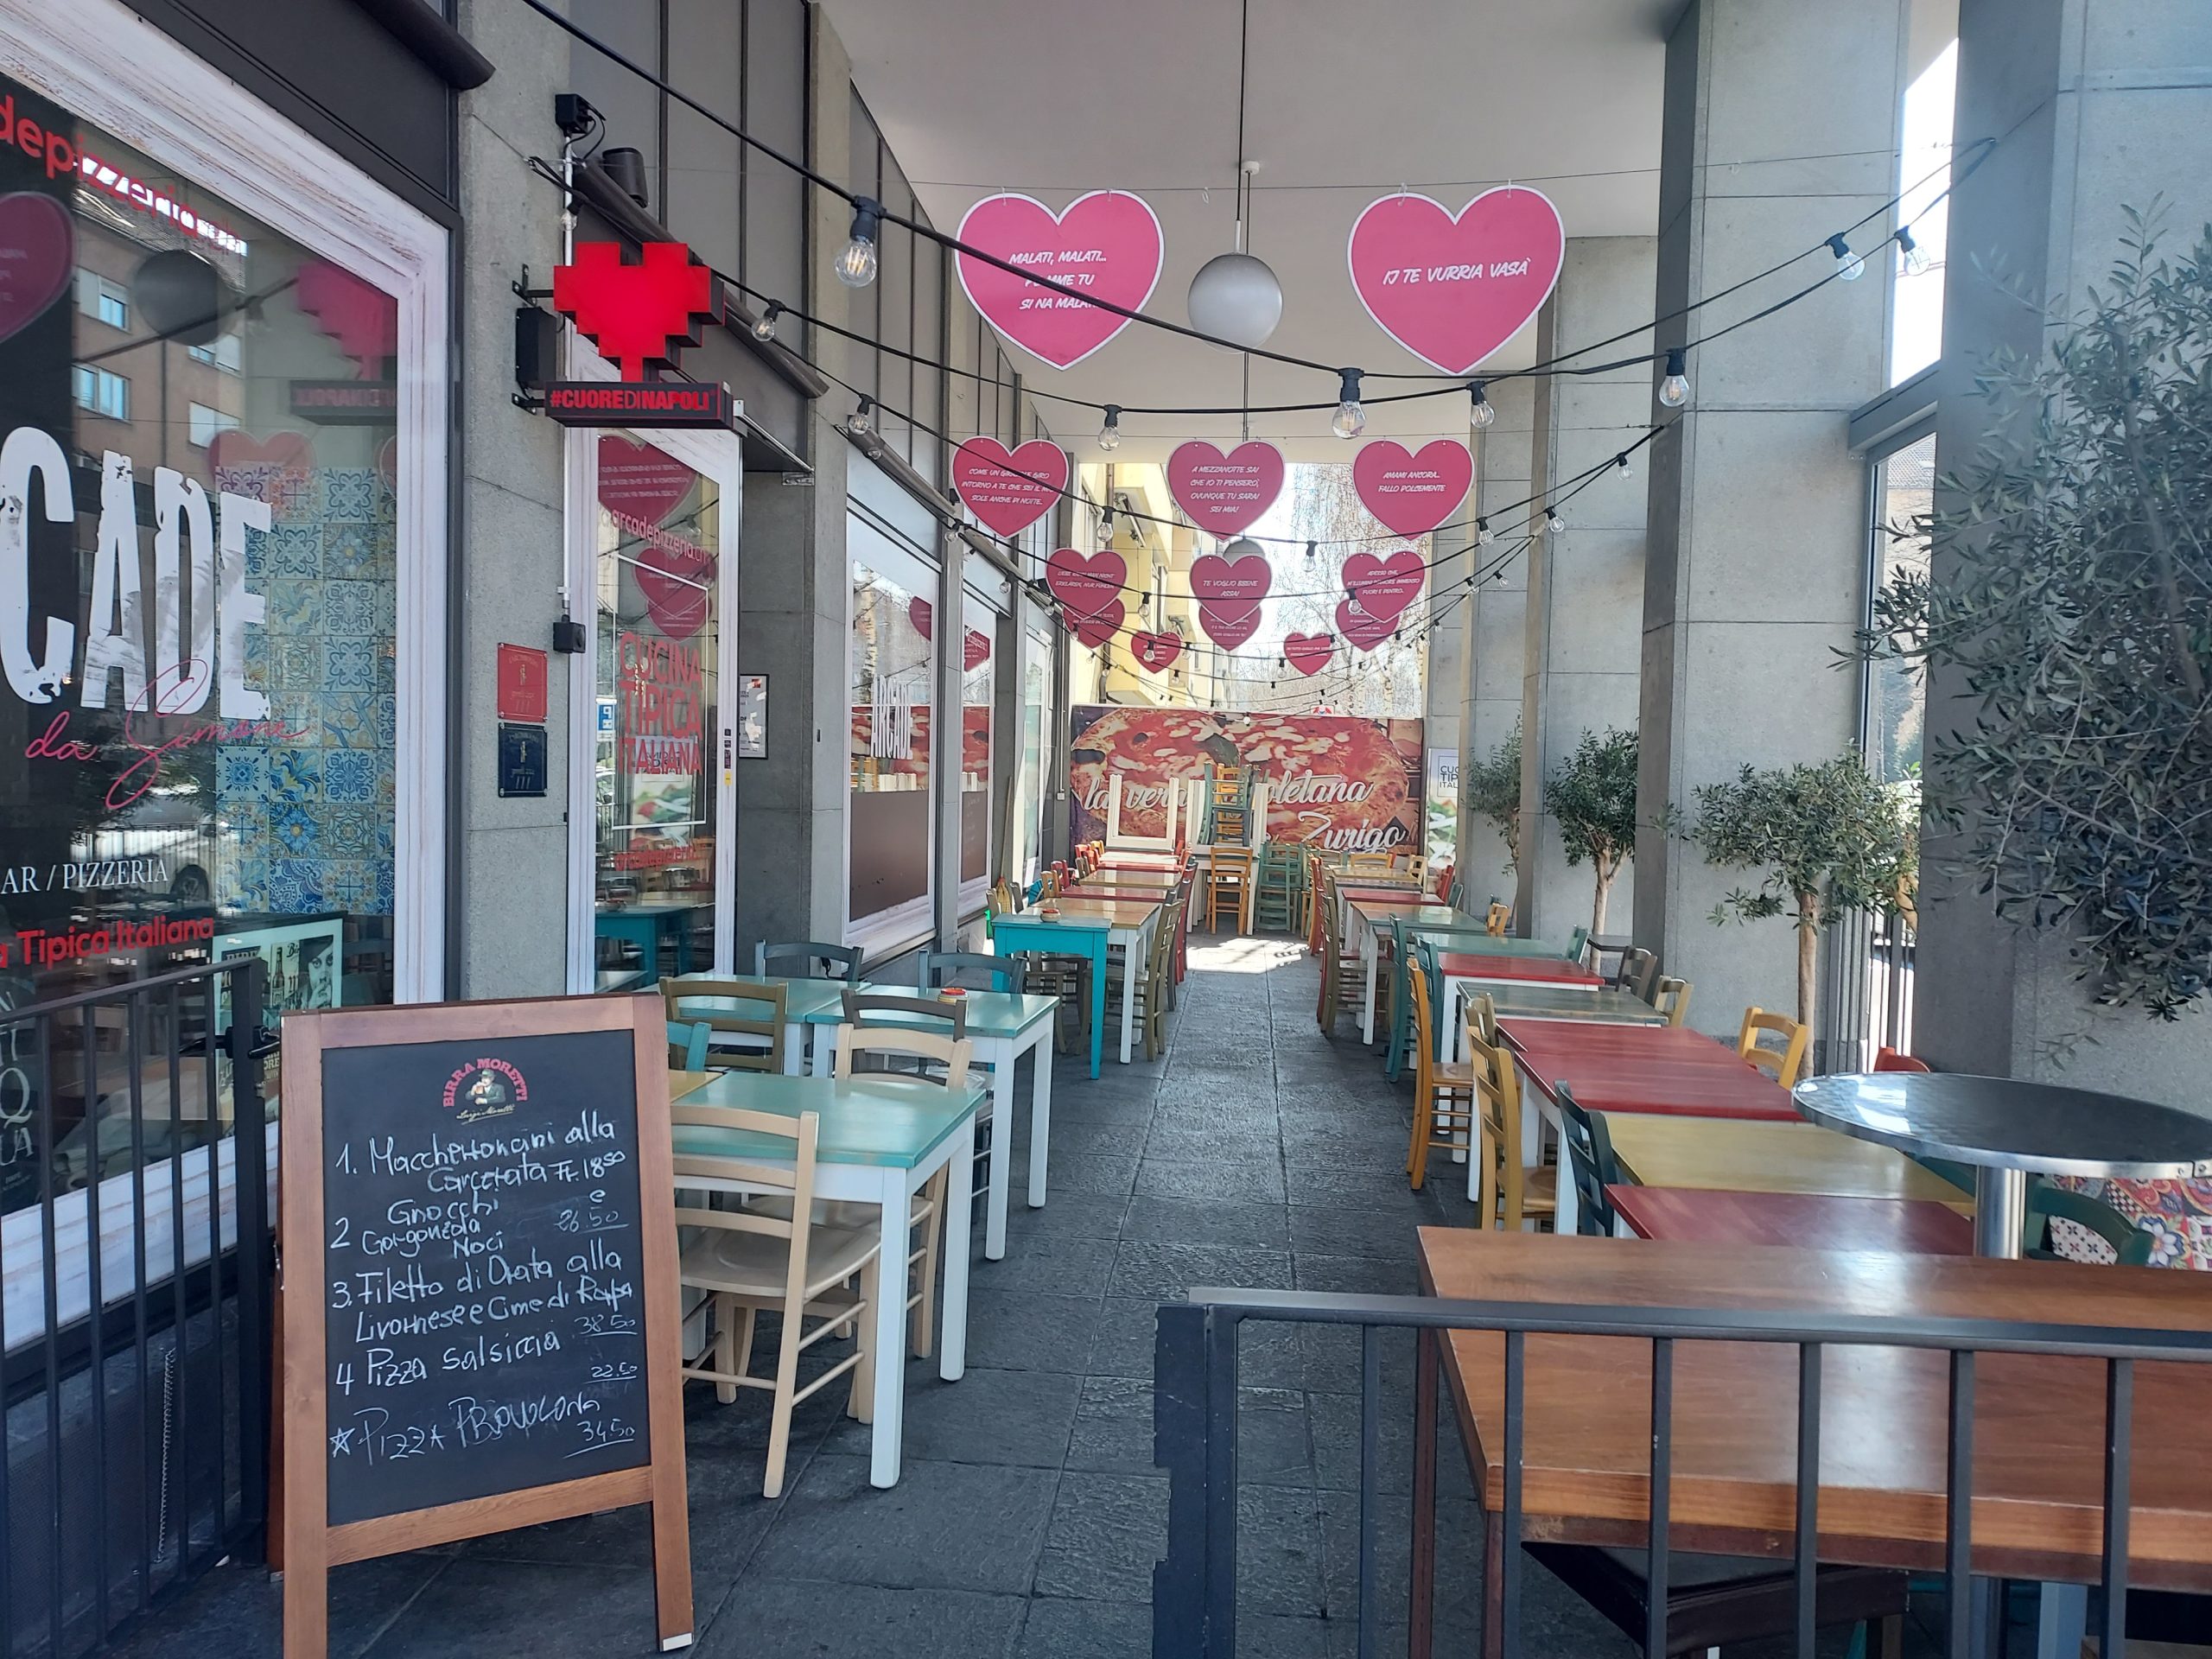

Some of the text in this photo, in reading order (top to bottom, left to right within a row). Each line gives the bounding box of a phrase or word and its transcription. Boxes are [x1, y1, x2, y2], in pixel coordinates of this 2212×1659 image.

[1008, 250, 1107, 265] MALATI, MALATI...
[1402, 268, 1422, 284] TE
[1427, 264, 1484, 283] VURRIA
[1077, 274, 1096, 285] TU
[1019, 299, 1034, 310] SI
[1034, 298, 1053, 308] NA
[550, 389, 710, 411] #CUOREDINAPOLI
[1382, 471, 1408, 480] AMAMI
[1400, 484, 1446, 493] DOLCEMENTE
[620, 631, 703, 690] CUCINA
[618, 679, 703, 741] TIPICA
[25, 710, 98, 760] da
[619, 736, 703, 775] ITALIANA
[1267, 768, 1375, 804] oletana
[1297, 810, 1407, 854] Zurigo
[62, 858, 168, 890] PIZZERIA
[16, 926, 111, 970] Tipica
[116, 914, 214, 951] Italiana
[443, 1058, 528, 1107] BIRRA MORETTI
[563, 1109, 617, 1146] alla
[387, 1192, 499, 1226] Gnocchi
[330, 1217, 351, 1249] 2
[453, 1230, 505, 1260] Noci
[355, 1263, 444, 1306] Filetto
[456, 1262, 482, 1294] di
[566, 1238, 622, 1273] alla
[335, 1363, 355, 1395] 4
[366, 1348, 428, 1387] Pizza
